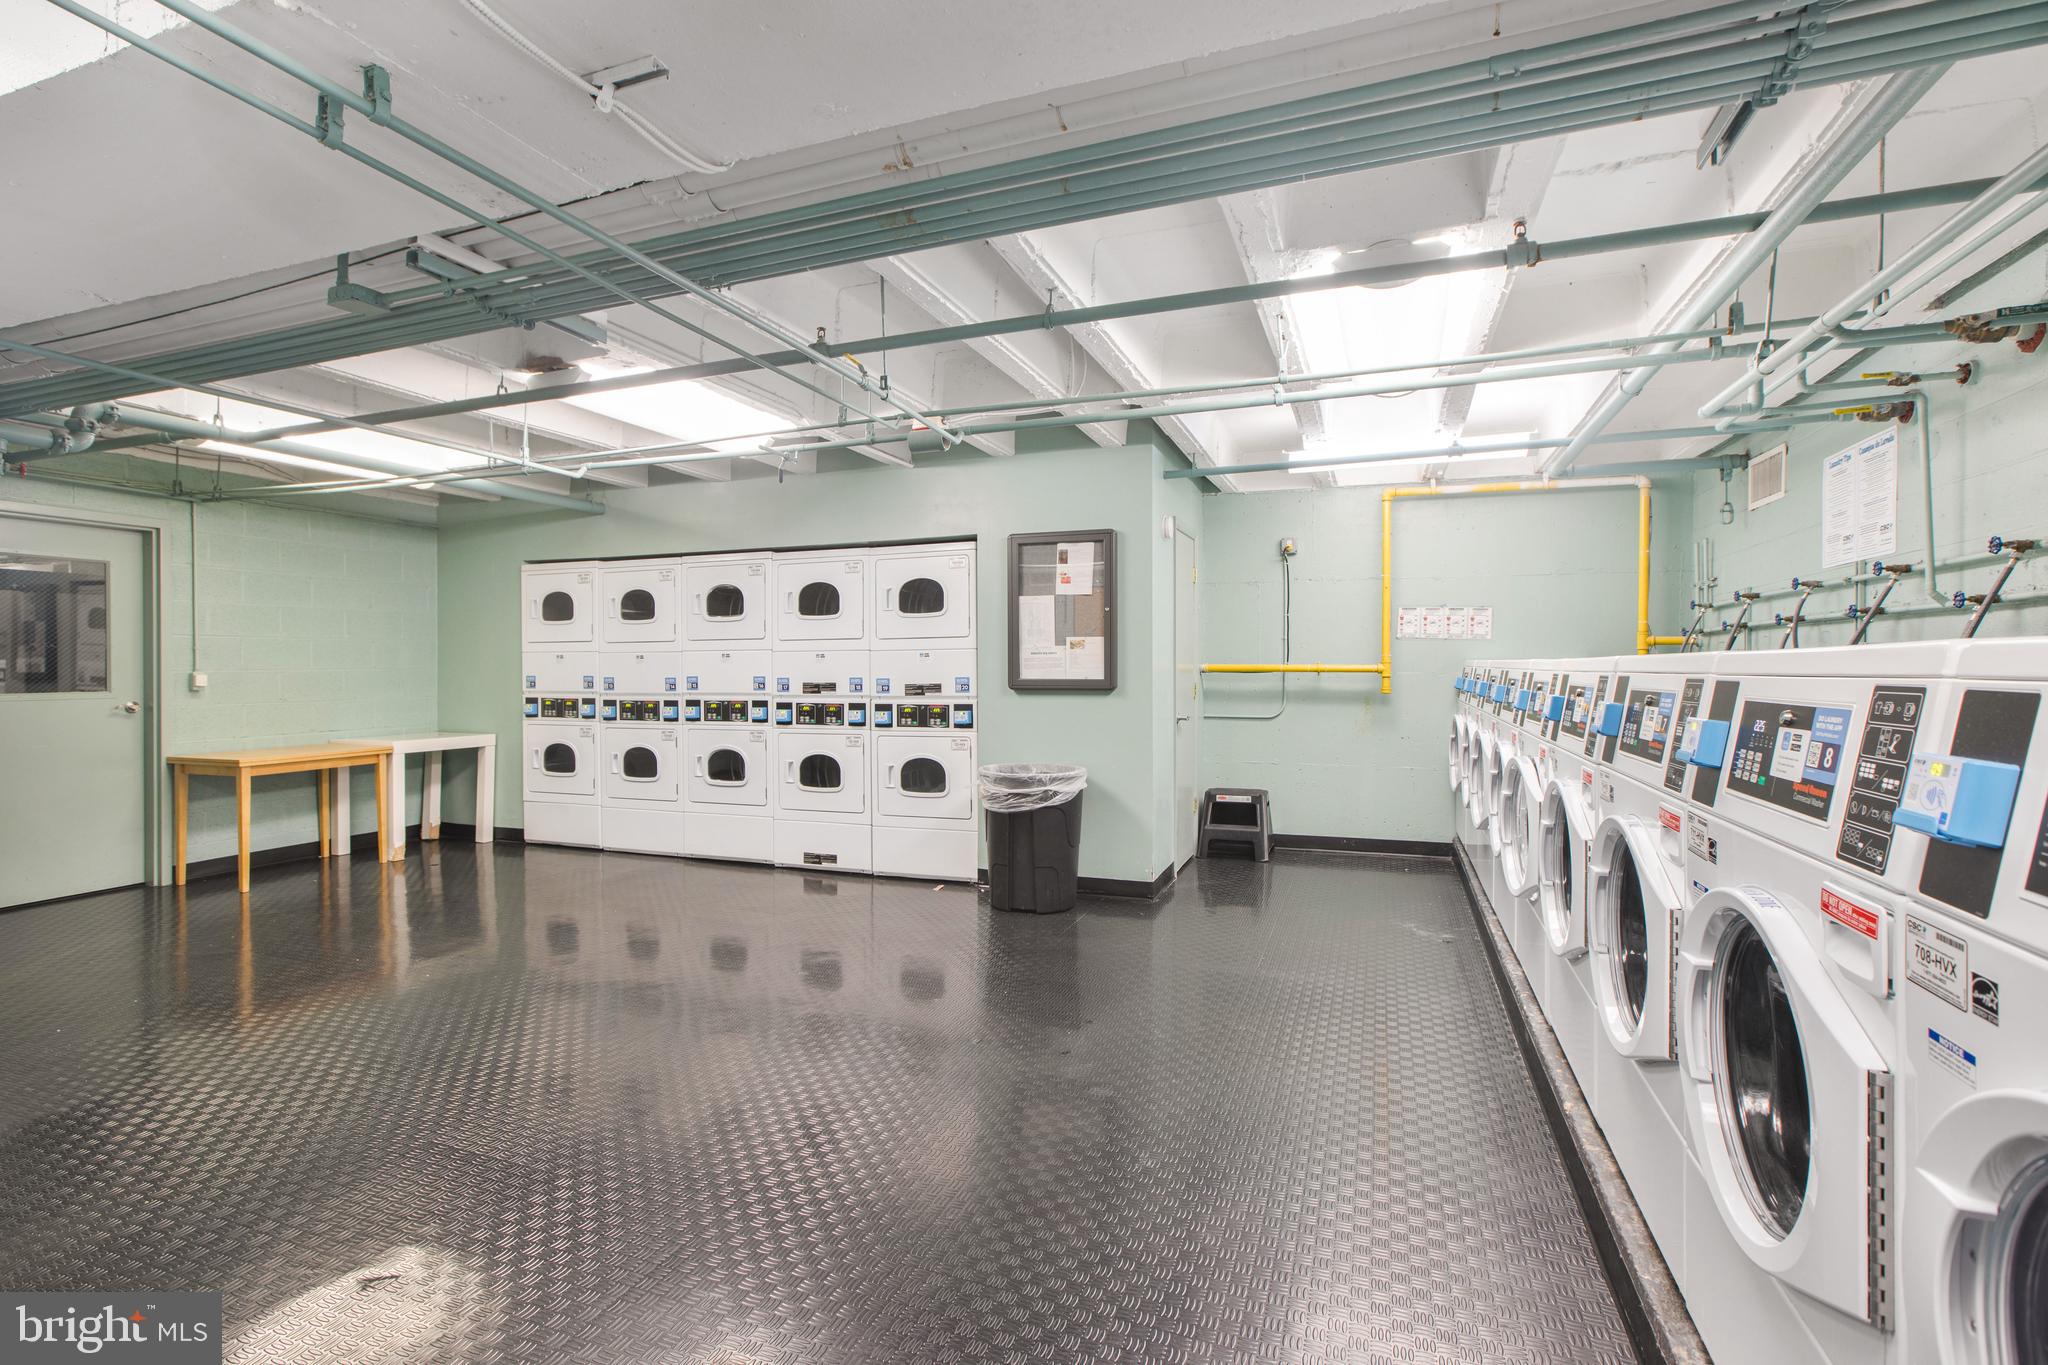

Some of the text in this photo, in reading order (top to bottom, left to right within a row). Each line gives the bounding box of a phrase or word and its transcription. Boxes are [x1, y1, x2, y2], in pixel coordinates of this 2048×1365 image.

[1823, 747, 1834, 769] 8
[1907, 919, 1922, 932] CSC
[1914, 943, 1958, 979] 708-HVX
